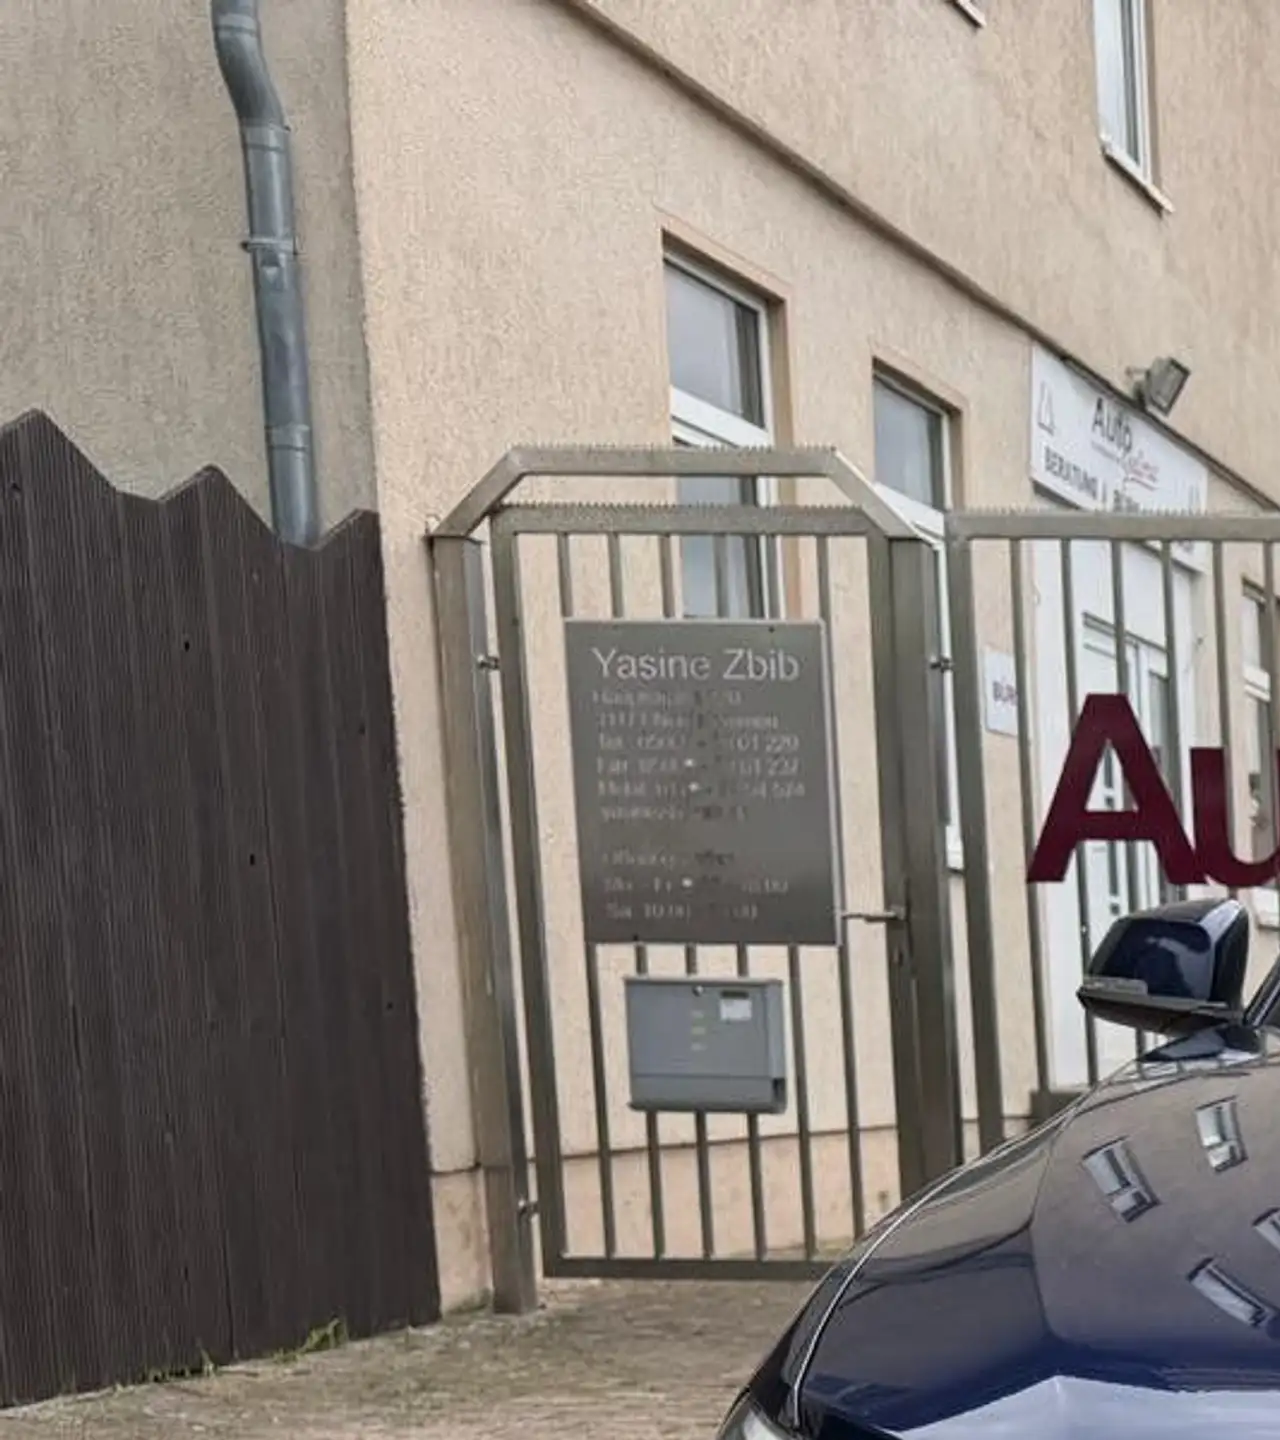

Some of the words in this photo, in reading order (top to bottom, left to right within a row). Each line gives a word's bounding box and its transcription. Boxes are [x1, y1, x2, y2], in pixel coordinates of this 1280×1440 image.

[1091, 397, 1133, 454] Auto
[592, 648, 711, 680] Yasine
[722, 648, 800, 681] Zbib
